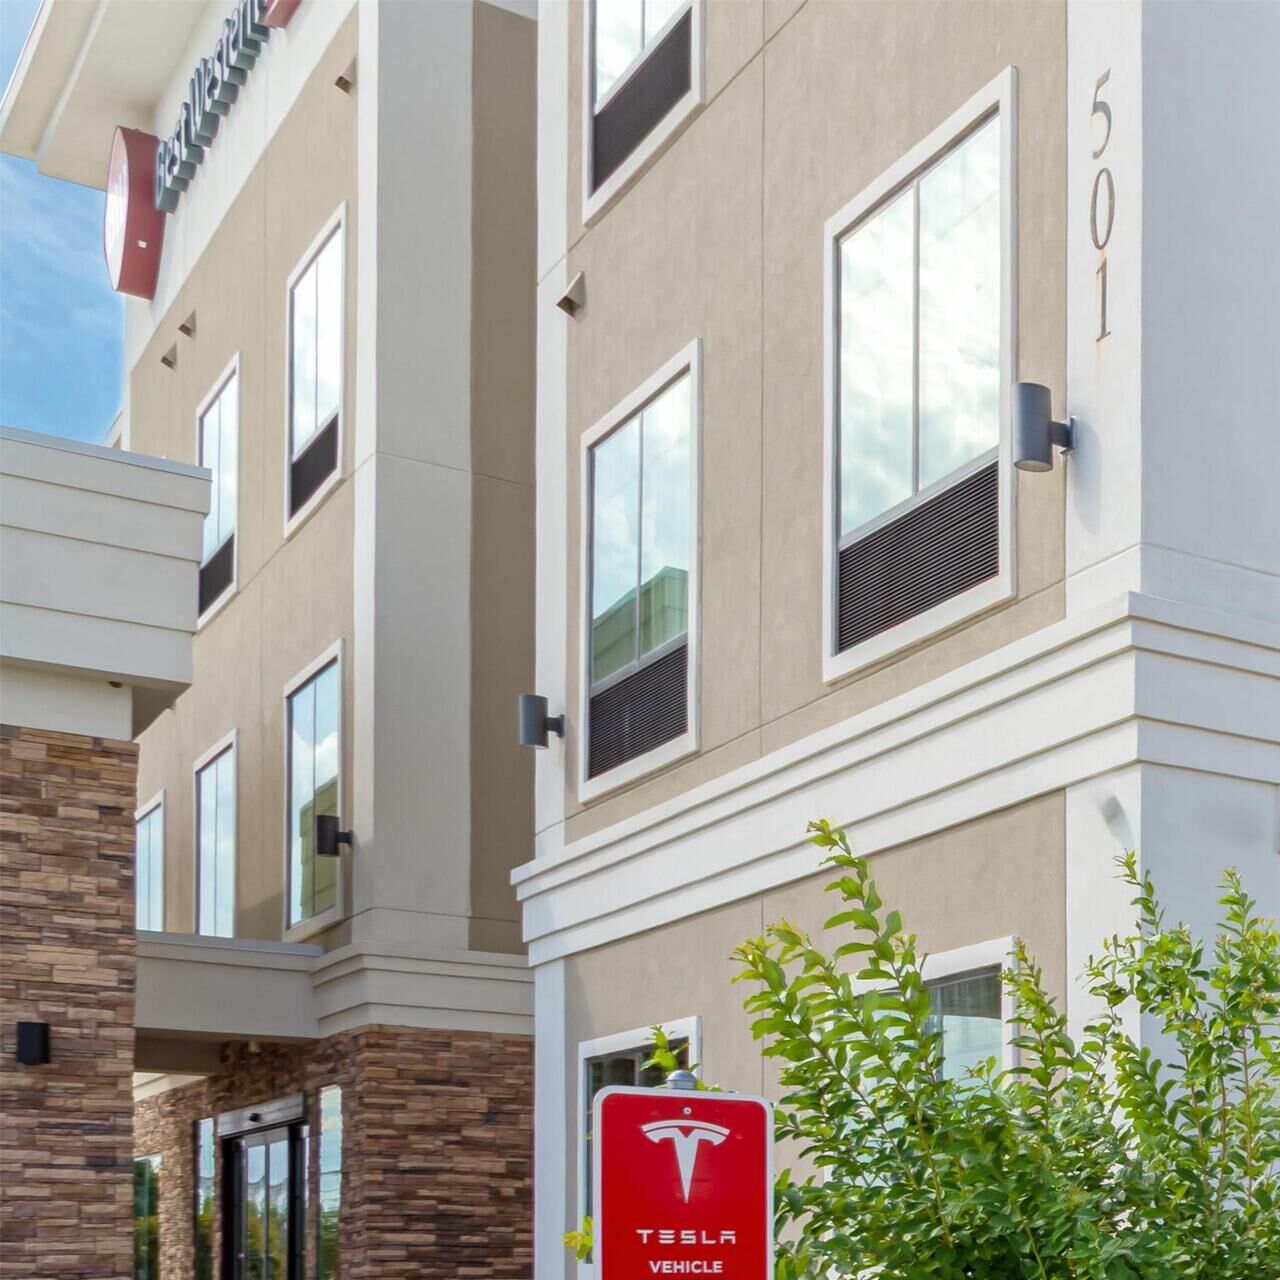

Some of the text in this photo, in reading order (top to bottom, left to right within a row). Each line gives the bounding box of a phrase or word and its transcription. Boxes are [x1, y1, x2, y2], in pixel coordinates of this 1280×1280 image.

[1090, 67, 1116, 343] 501
[636, 1229, 736, 1245] TESLA
[649, 1260, 723, 1273] VEHICLE
